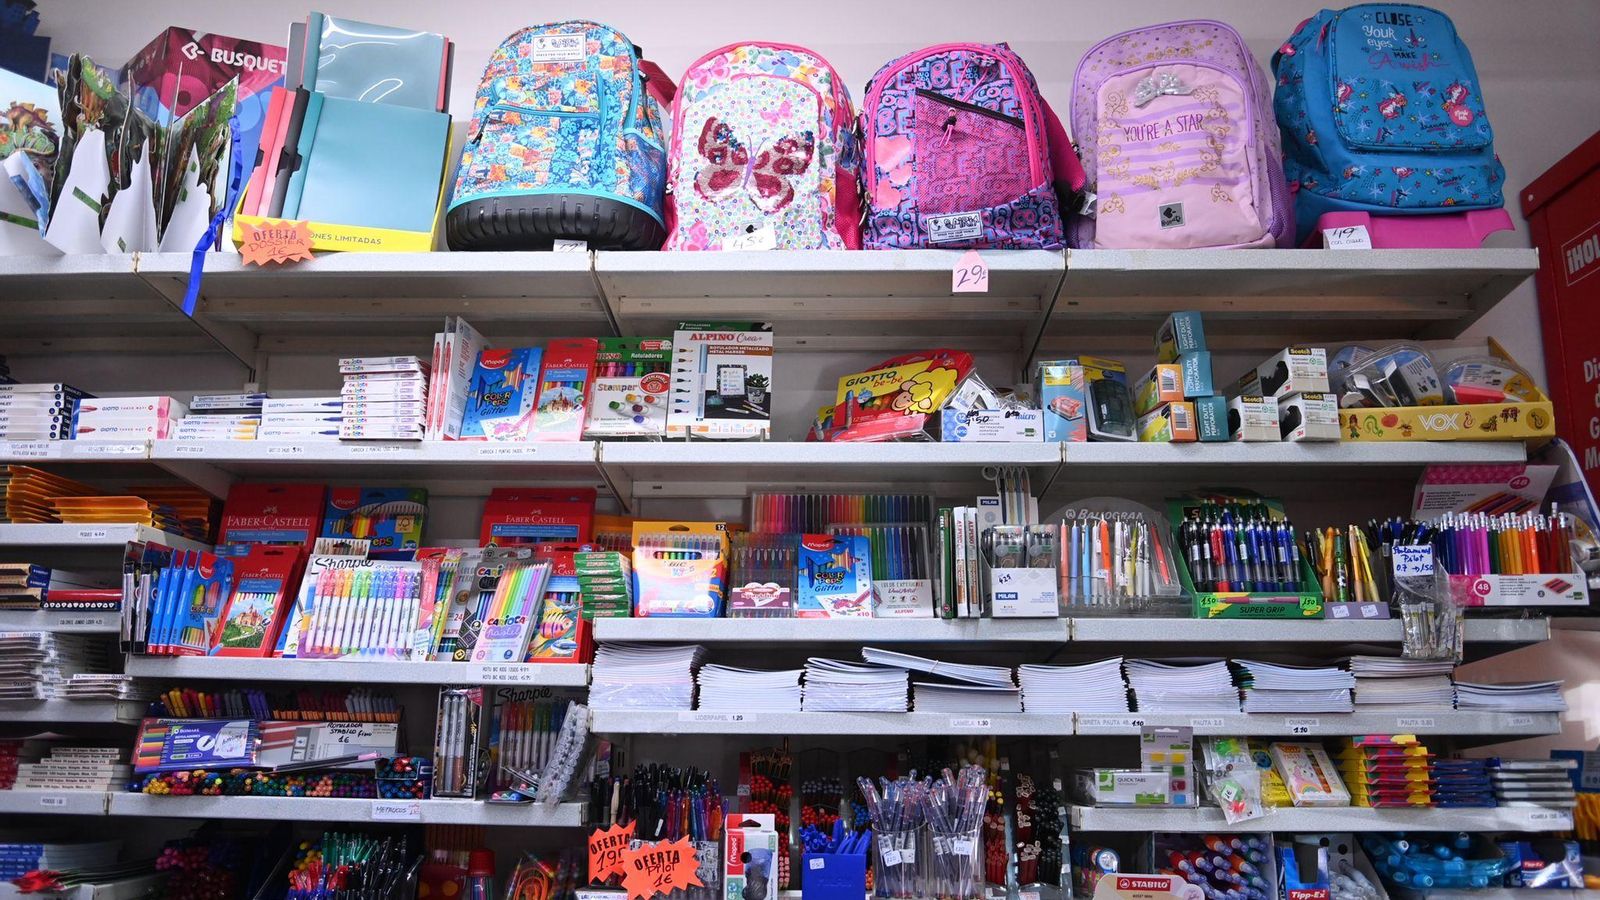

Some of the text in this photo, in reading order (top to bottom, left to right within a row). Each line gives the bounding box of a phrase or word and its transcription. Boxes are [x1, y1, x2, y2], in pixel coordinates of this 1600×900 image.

[1375, 11, 1413, 27] CLOSE
[1123, 113, 1206, 142] YOU'RE A STAR
[253, 228, 298, 242] OFERTA
[334, 234, 382, 246] LIMITADAS
[679, 322, 686, 330] 7
[689, 333, 735, 341] ALPINO
[845, 370, 898, 388] GIOTTO
[597, 383, 638, 393] Stamper
[480, 406, 508, 417] Glitter
[1418, 413, 1461, 431] VOX
[226, 514, 311, 527] FABER-CASTELL
[505, 514, 566, 524] FABER-CASTELL
[814, 585, 844, 593] Glitter
[1477, 583, 1490, 591] 48
[1239, 606, 1285, 614] SUPER GRIP
[497, 685, 553, 702] Sharpie
[1400, 718, 1420, 726] PAUTA
[590, 833, 631, 855] OFERTA
[634, 850, 681, 871] OFERTA
[1131, 880, 1168, 888] STABILO
[1290, 890, 1325, 900] Tipp-Ex
